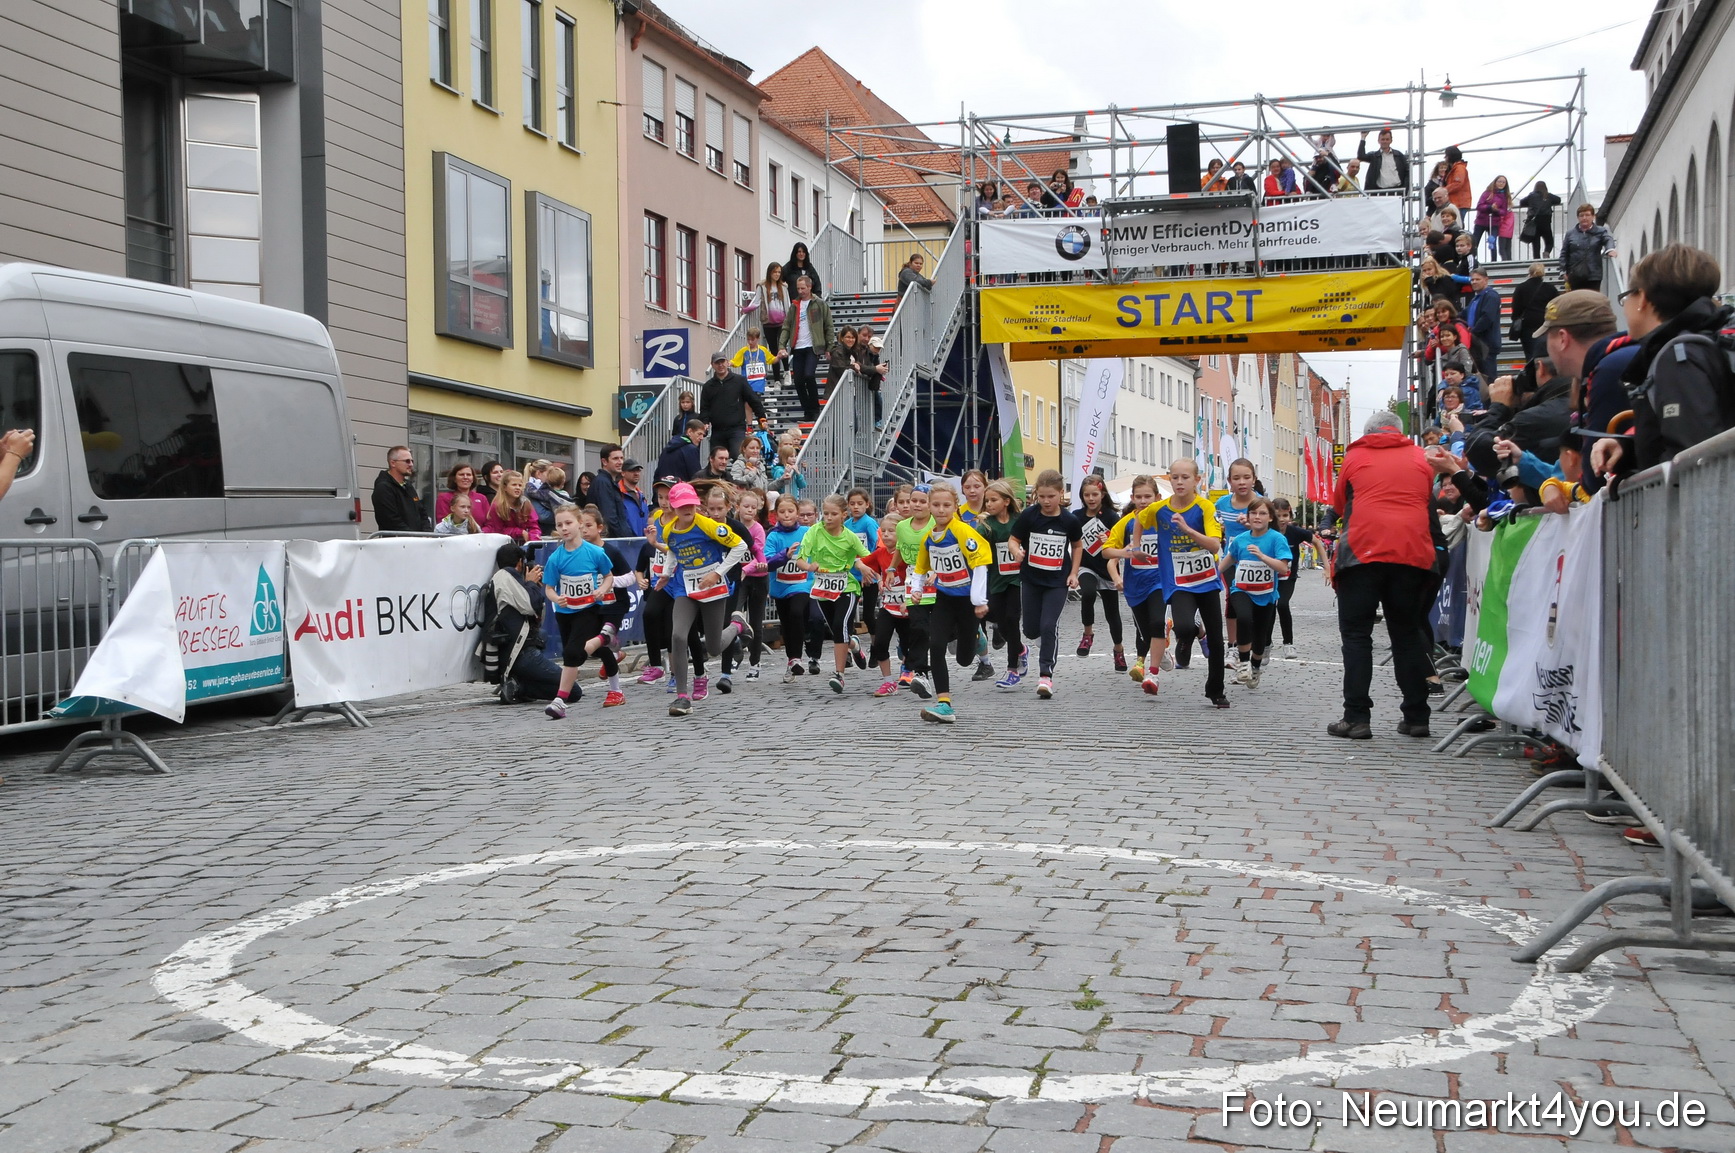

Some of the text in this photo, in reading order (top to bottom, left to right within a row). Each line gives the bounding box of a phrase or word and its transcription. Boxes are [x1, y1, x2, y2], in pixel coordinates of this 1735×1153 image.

[1101, 245, 1149, 257] Weniger
[1151, 241, 1215, 254] Verbrauch.
[1218, 238, 1249, 250] Mehr
[1116, 289, 1263, 328] START
[1290, 301, 1385, 313] Neumarkter Stadtlauf
[1003, 314, 1092, 324] Neumarkter Stadtlauf
[748, 366, 764, 374] 7210
[1081, 408, 1102, 475] Audi BKK
[1033, 541, 1063, 557] 7555
[933, 555, 962, 571] 7196
[1177, 556, 1211, 574] 7130
[1239, 569, 1272, 582] 7028
[562, 582, 591, 597] 7063
[817, 577, 845, 591] 7060
[294, 592, 443, 642] Audi BKK
